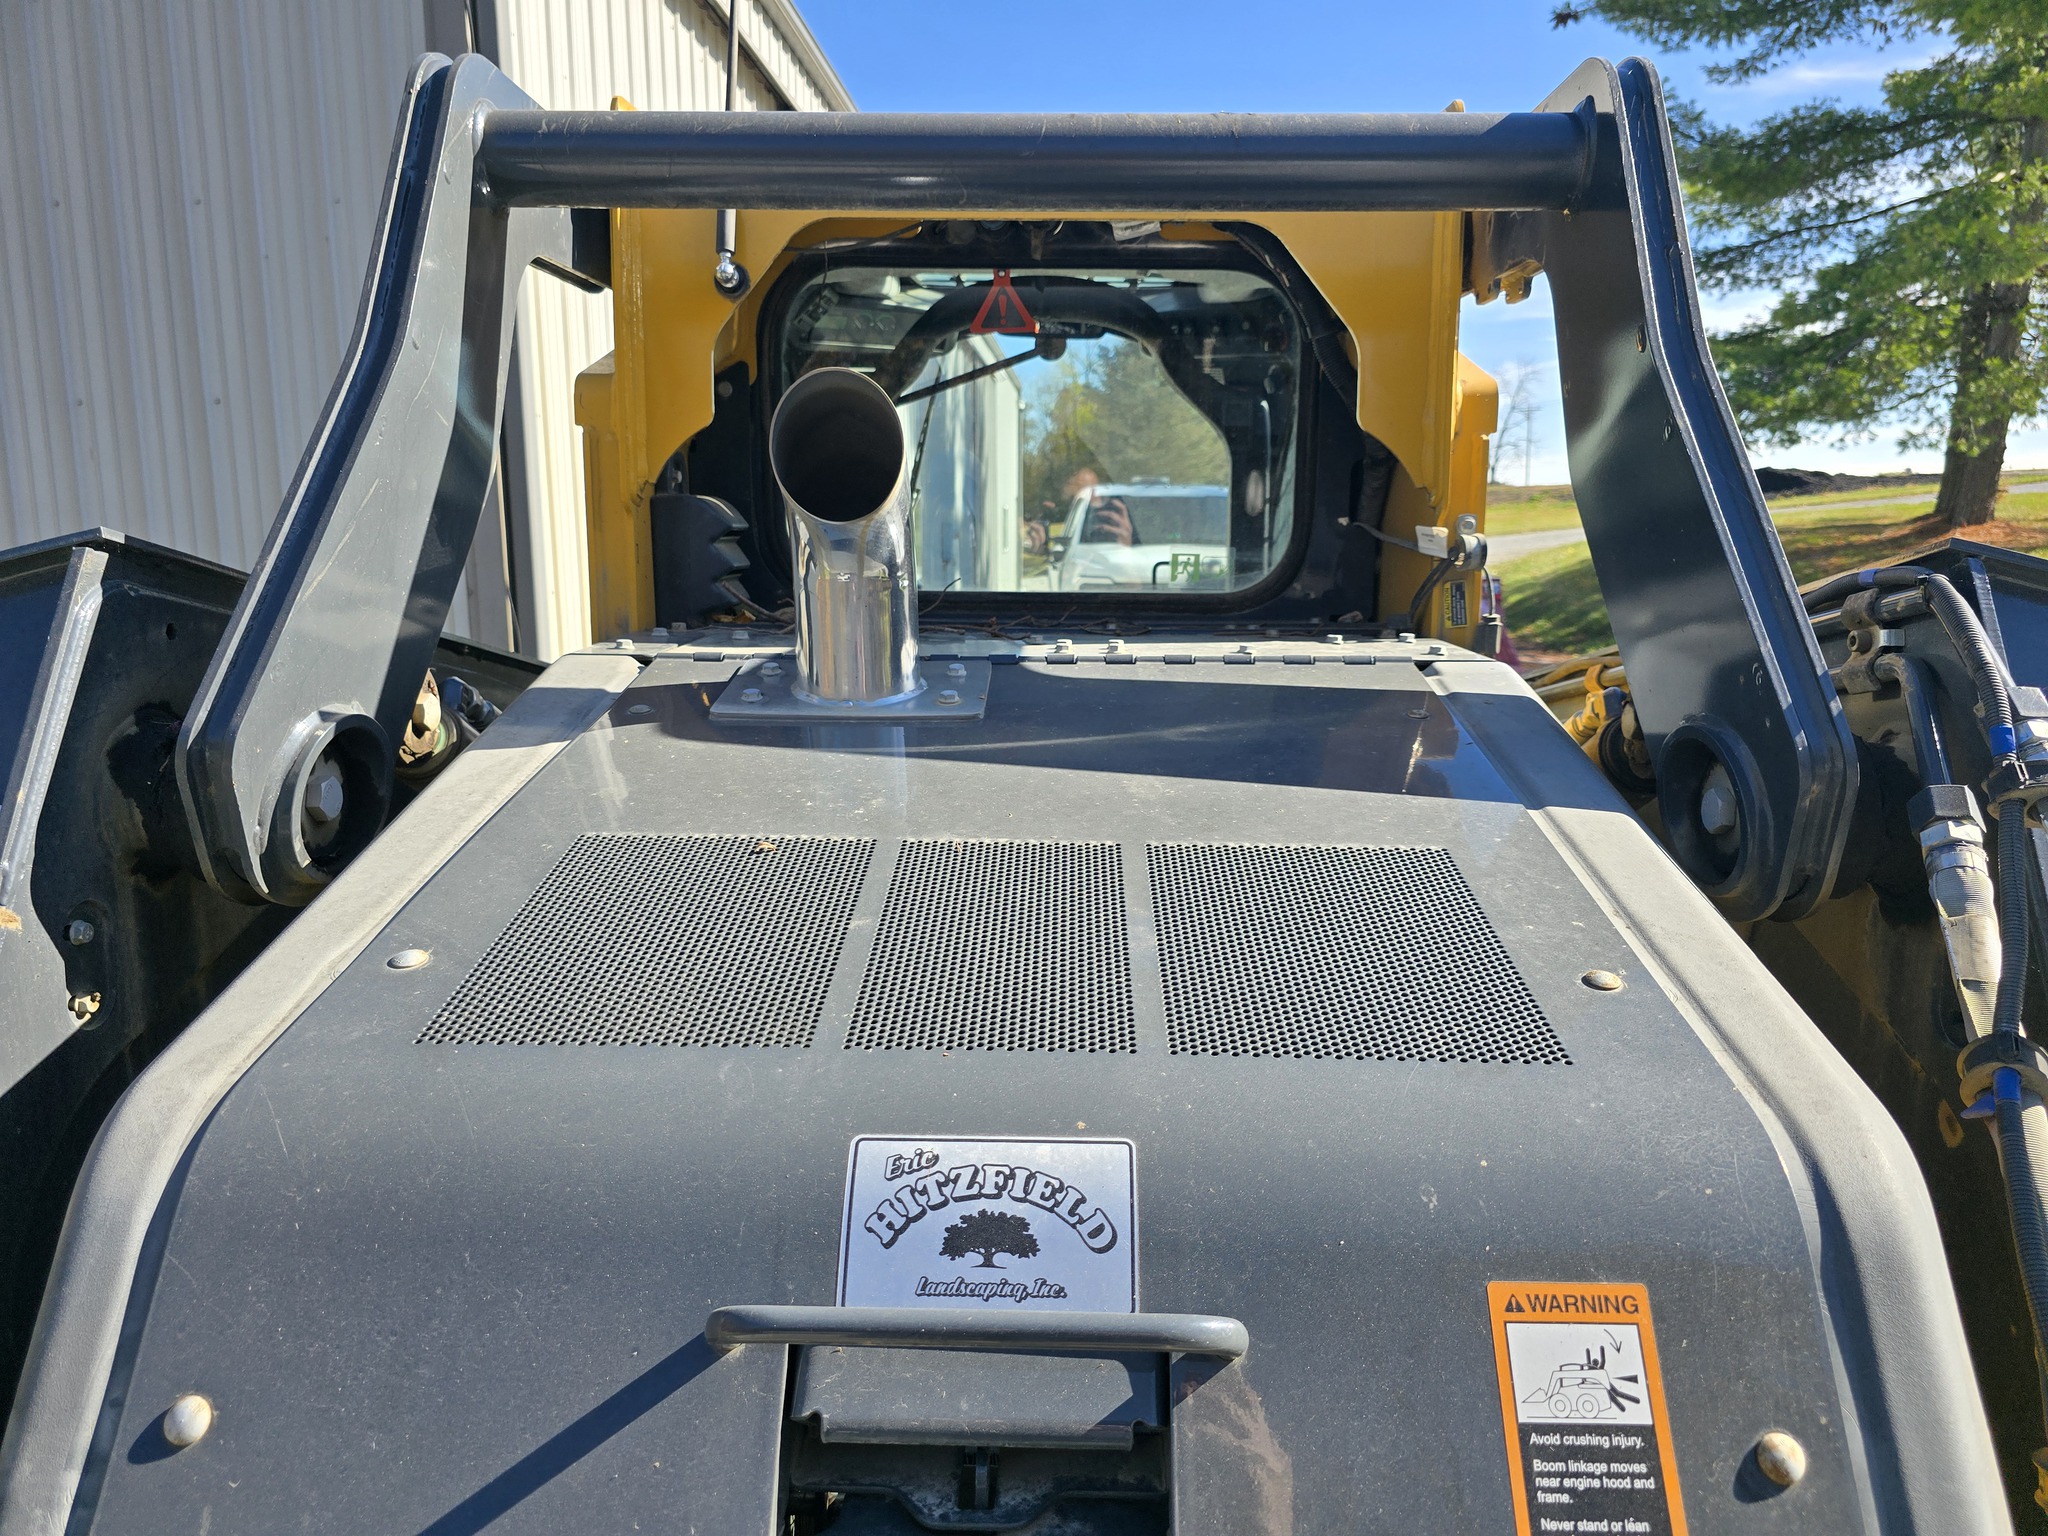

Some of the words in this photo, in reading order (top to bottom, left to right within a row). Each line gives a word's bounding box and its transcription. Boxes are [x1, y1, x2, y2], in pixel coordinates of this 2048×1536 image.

[884, 1148, 939, 1181] Eric
[864, 1163, 1118, 1254] HITZFIELD
[915, 1276, 1030, 1303] Landscaping,
[1029, 1277, 1068, 1299] Inc.
[1525, 1293, 1640, 1314] WARNING
[1529, 1432, 1560, 1445] Avoid
[1563, 1433, 1610, 1448] crushing
[1612, 1433, 1645, 1448] injury.
[1533, 1459, 1566, 1473] Boom
[1568, 1460, 1608, 1475] linkage
[1610, 1462, 1647, 1473] moves
[1535, 1477, 1561, 1487] near
[1563, 1476, 1600, 1491] engine
[1603, 1476, 1631, 1488] hood
[1634, 1476, 1655, 1489] and
[1537, 1490, 1573, 1504] frame.
[1540, 1518, 1575, 1531] Never
[1577, 1518, 1607, 1531] stand
[1610, 1521, 1623, 1532] or
[1625, 1518, 1650, 1532] lean
